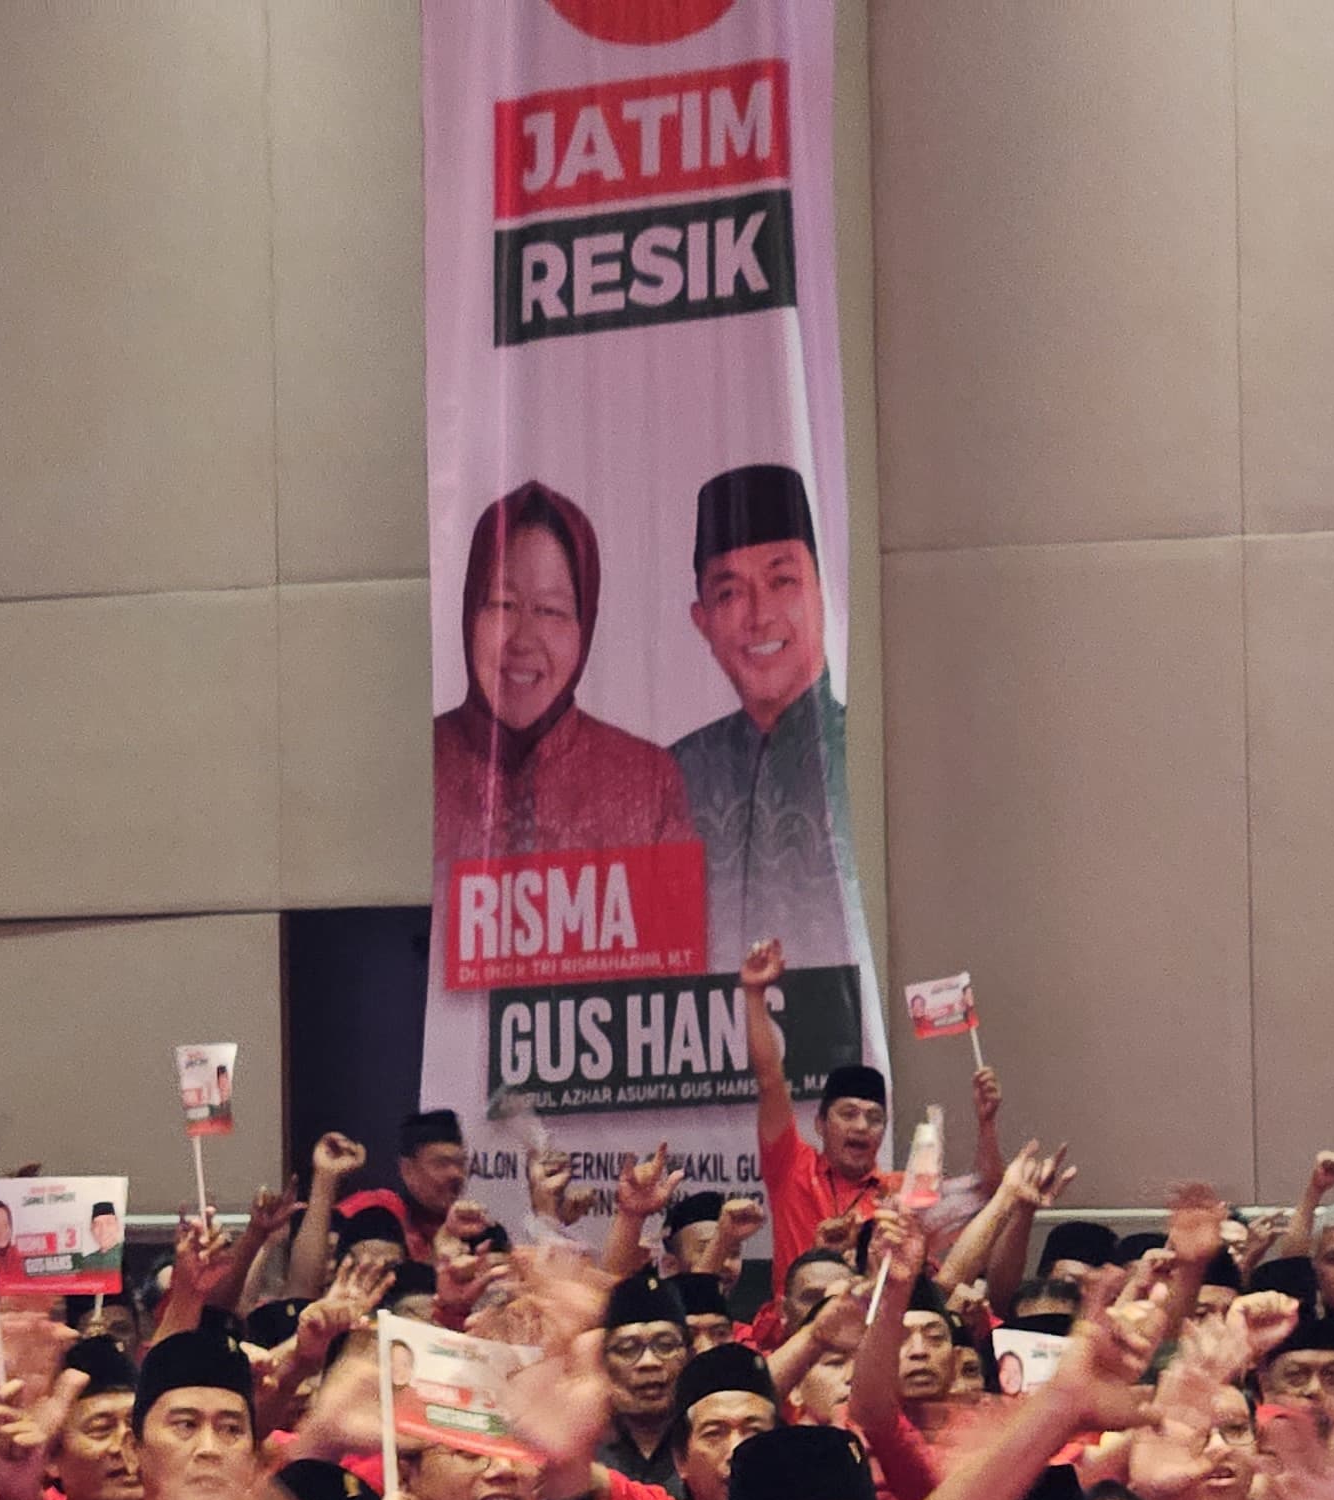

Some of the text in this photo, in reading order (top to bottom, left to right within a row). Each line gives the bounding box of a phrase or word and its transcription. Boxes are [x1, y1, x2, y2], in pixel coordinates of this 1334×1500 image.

[521, 77, 773, 194] JATIM
[520, 211, 770, 324] RESIK
[458, 861, 638, 962] RISMA
[500, 997, 613, 1086] GUS
[560, 1085, 613, 1106] AZHAR
[617, 1082, 676, 1102] ASUMTA
[680, 1080, 713, 1098] GUS
[468, 1151, 518, 1180] ALON
